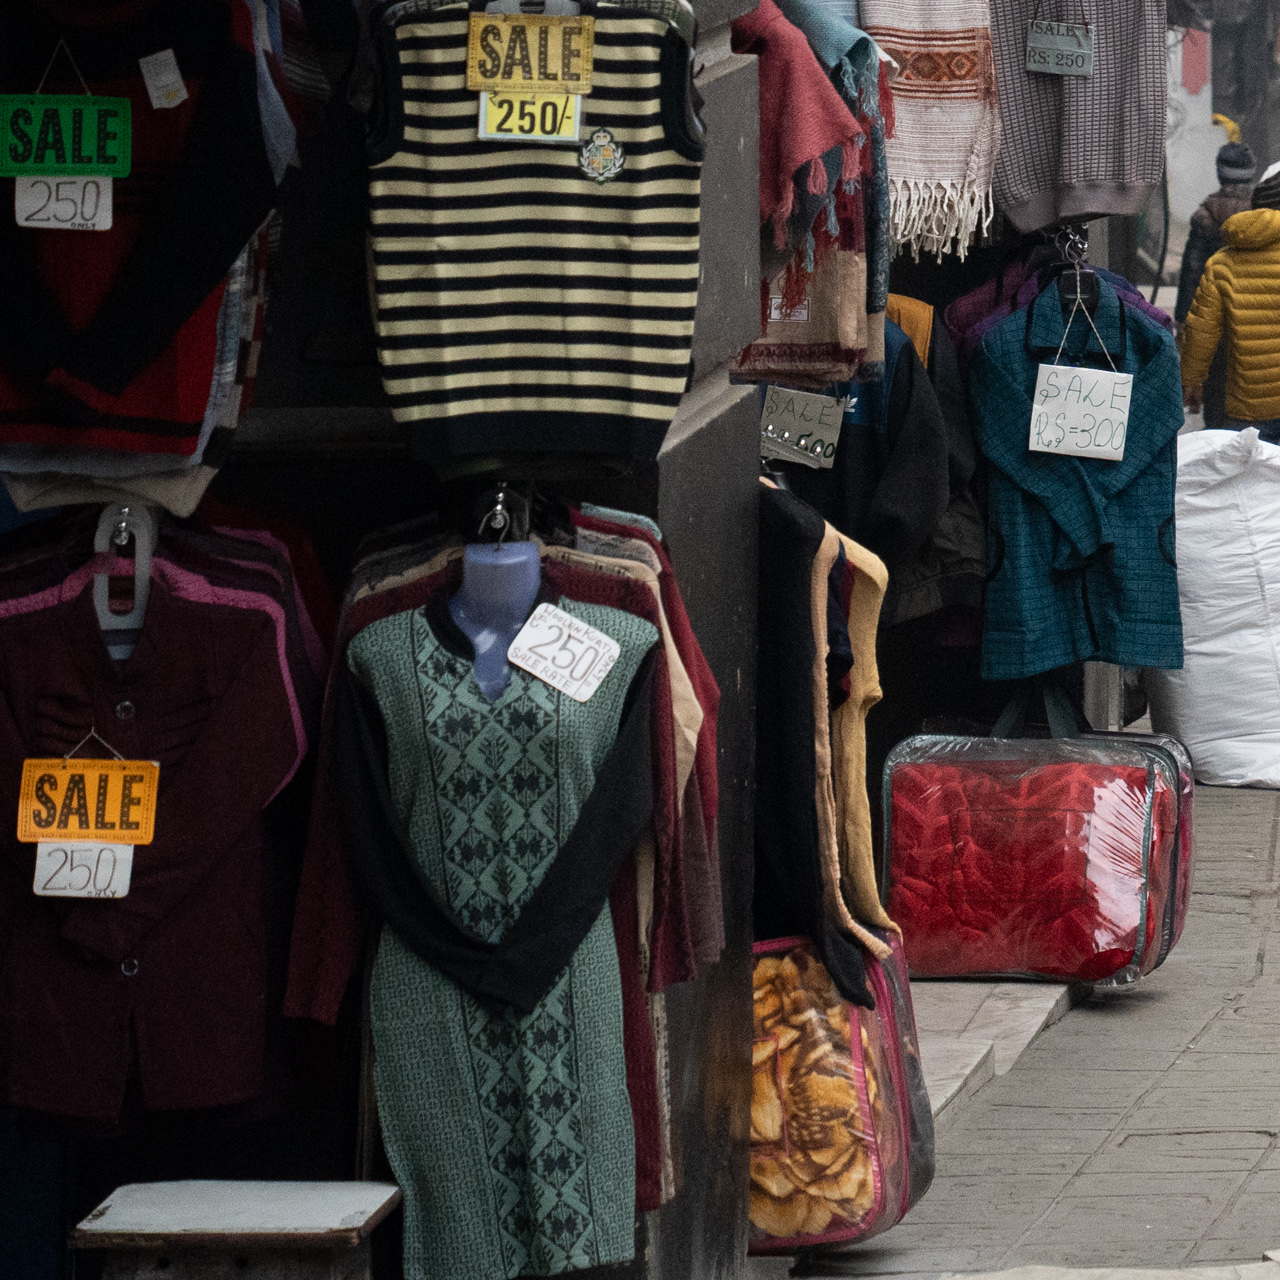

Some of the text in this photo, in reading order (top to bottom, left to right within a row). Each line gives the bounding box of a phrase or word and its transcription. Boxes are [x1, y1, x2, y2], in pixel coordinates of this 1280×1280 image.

[1034, 21, 1077, 38] SALE
[478, 23, 583, 82] SALE
[1027, 50, 1086, 68] RS: 250
[9, 108, 119, 165] SALE
[24, 179, 101, 224] 250
[766, 391, 836, 429] SALE
[1039, 371, 1132, 415] SALE
[509, 646, 574, 690] SALE RATE
[32, 773, 145, 831] SALE
[41, 847, 118, 892] 250
